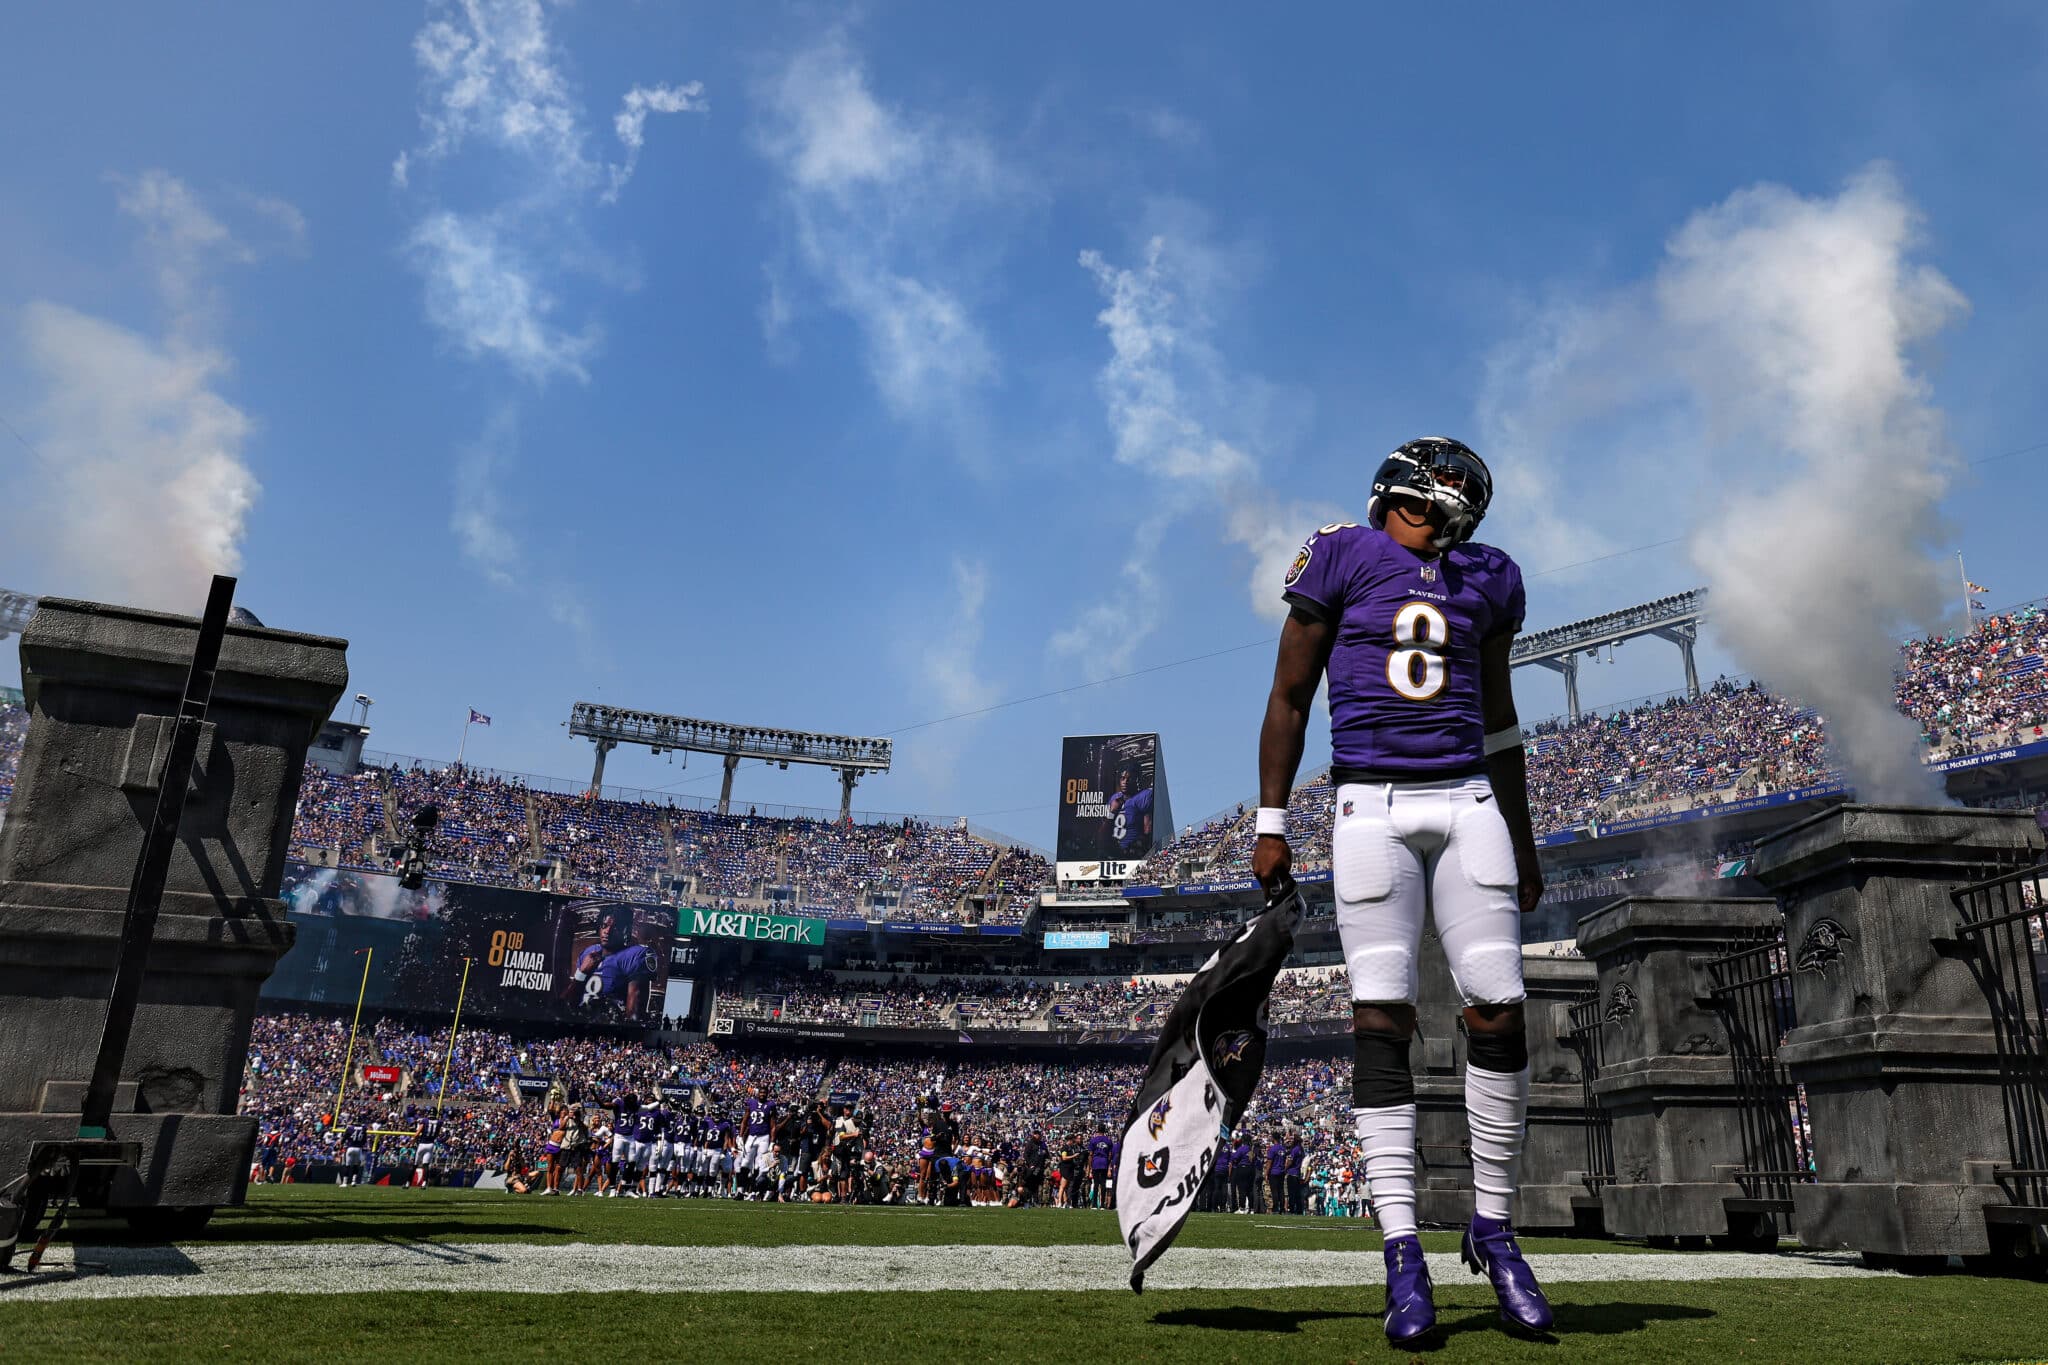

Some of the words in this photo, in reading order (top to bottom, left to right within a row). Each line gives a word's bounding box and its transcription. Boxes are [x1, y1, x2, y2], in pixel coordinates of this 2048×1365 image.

[1408, 588, 1447, 601] RAVENS
[1385, 601, 1449, 701] 8
[1981, 750, 2017, 763] 1997-2002
[1066, 778, 1078, 804] 8
[1078, 779, 1089, 791] QB
[1076, 792, 1104, 804] LAMAR
[1075, 804, 1111, 818] JACKSON
[1113, 814, 1127, 840] 8
[1099, 862, 1128, 880] Lite
[1209, 884, 1225, 893] RING
[1230, 881, 1254, 891] HONOR
[691, 910, 754, 938] M&T
[754, 916, 811, 942] Bank
[488, 930, 507, 967] 8
[507, 932, 525, 950] QB
[504, 949, 545, 972] LAMAR
[500, 969, 553, 992] JACKSON
[717, 1021, 731, 1033] 25
[518, 1079, 549, 1089] GEICO
[662, 1087, 691, 1097] GEICO
[638, 1116, 655, 1132] 58
[750, 1110, 765, 1125] 93
[426, 1123, 438, 1137] 11
